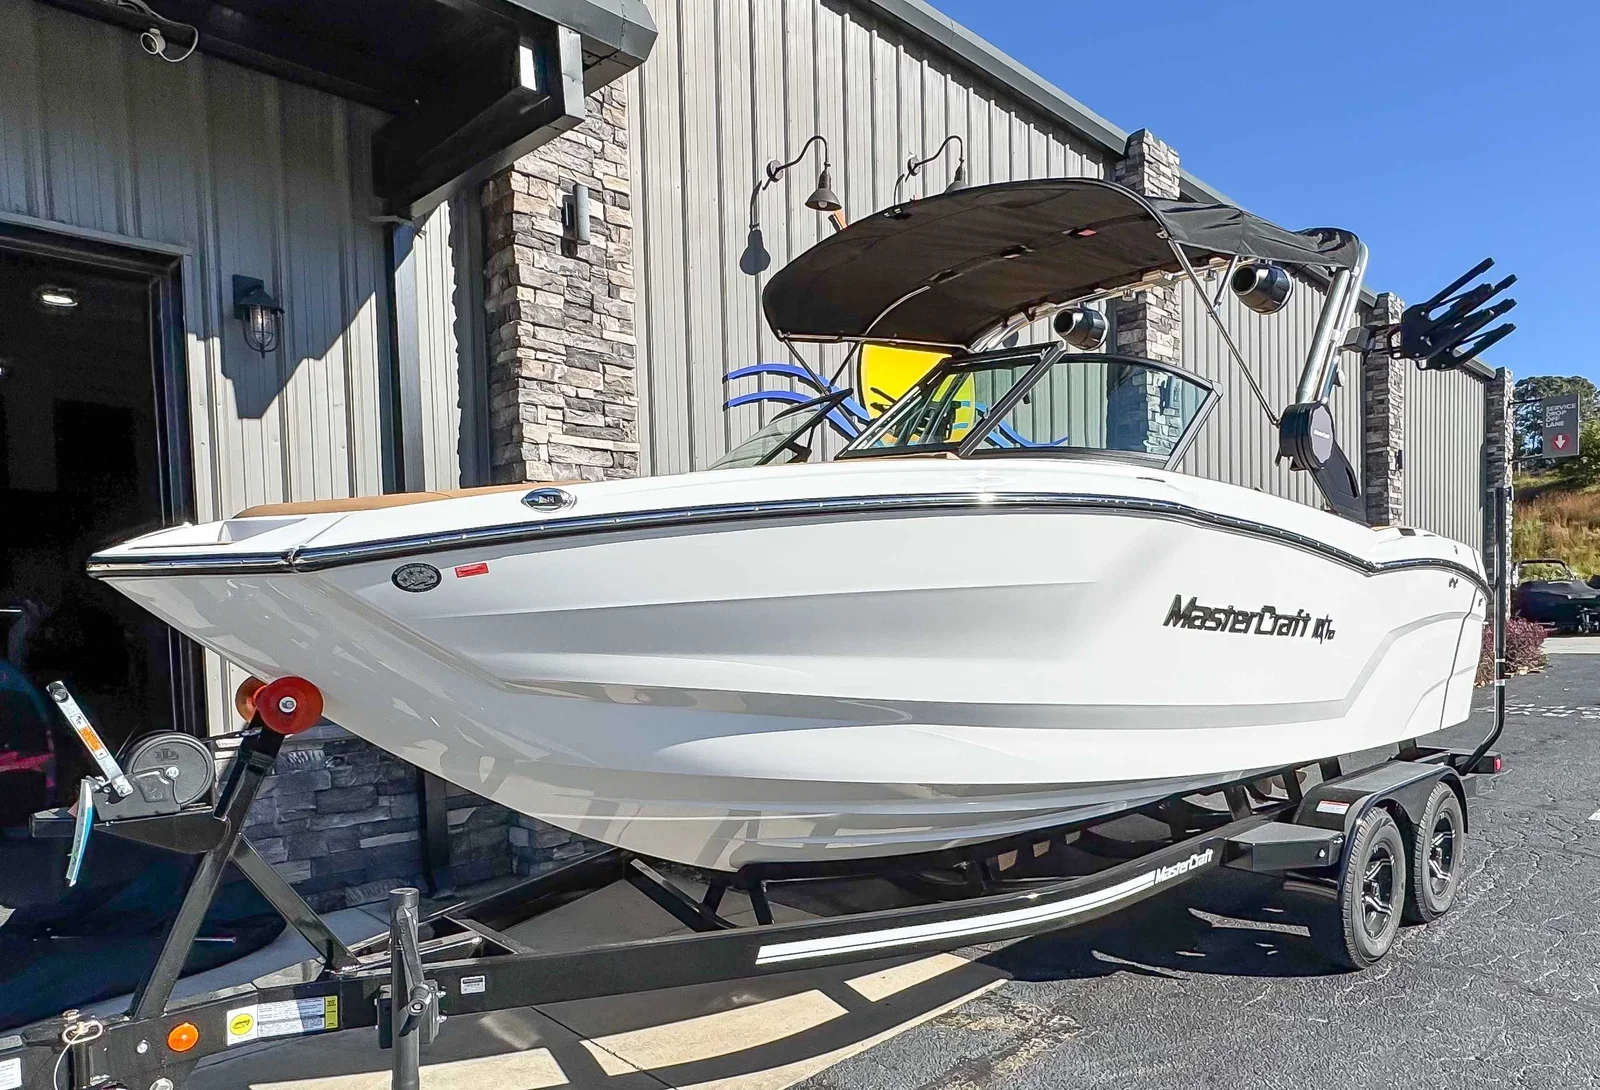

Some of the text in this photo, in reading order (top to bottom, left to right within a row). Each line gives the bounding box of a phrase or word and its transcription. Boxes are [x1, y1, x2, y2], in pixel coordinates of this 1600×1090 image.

[1546, 403, 1576, 411] SERVICE
[1546, 420, 1564, 428] LANE
[1163, 594, 1312, 637] MasterCraft
[1154, 848, 1214, 884] MasterCraft
